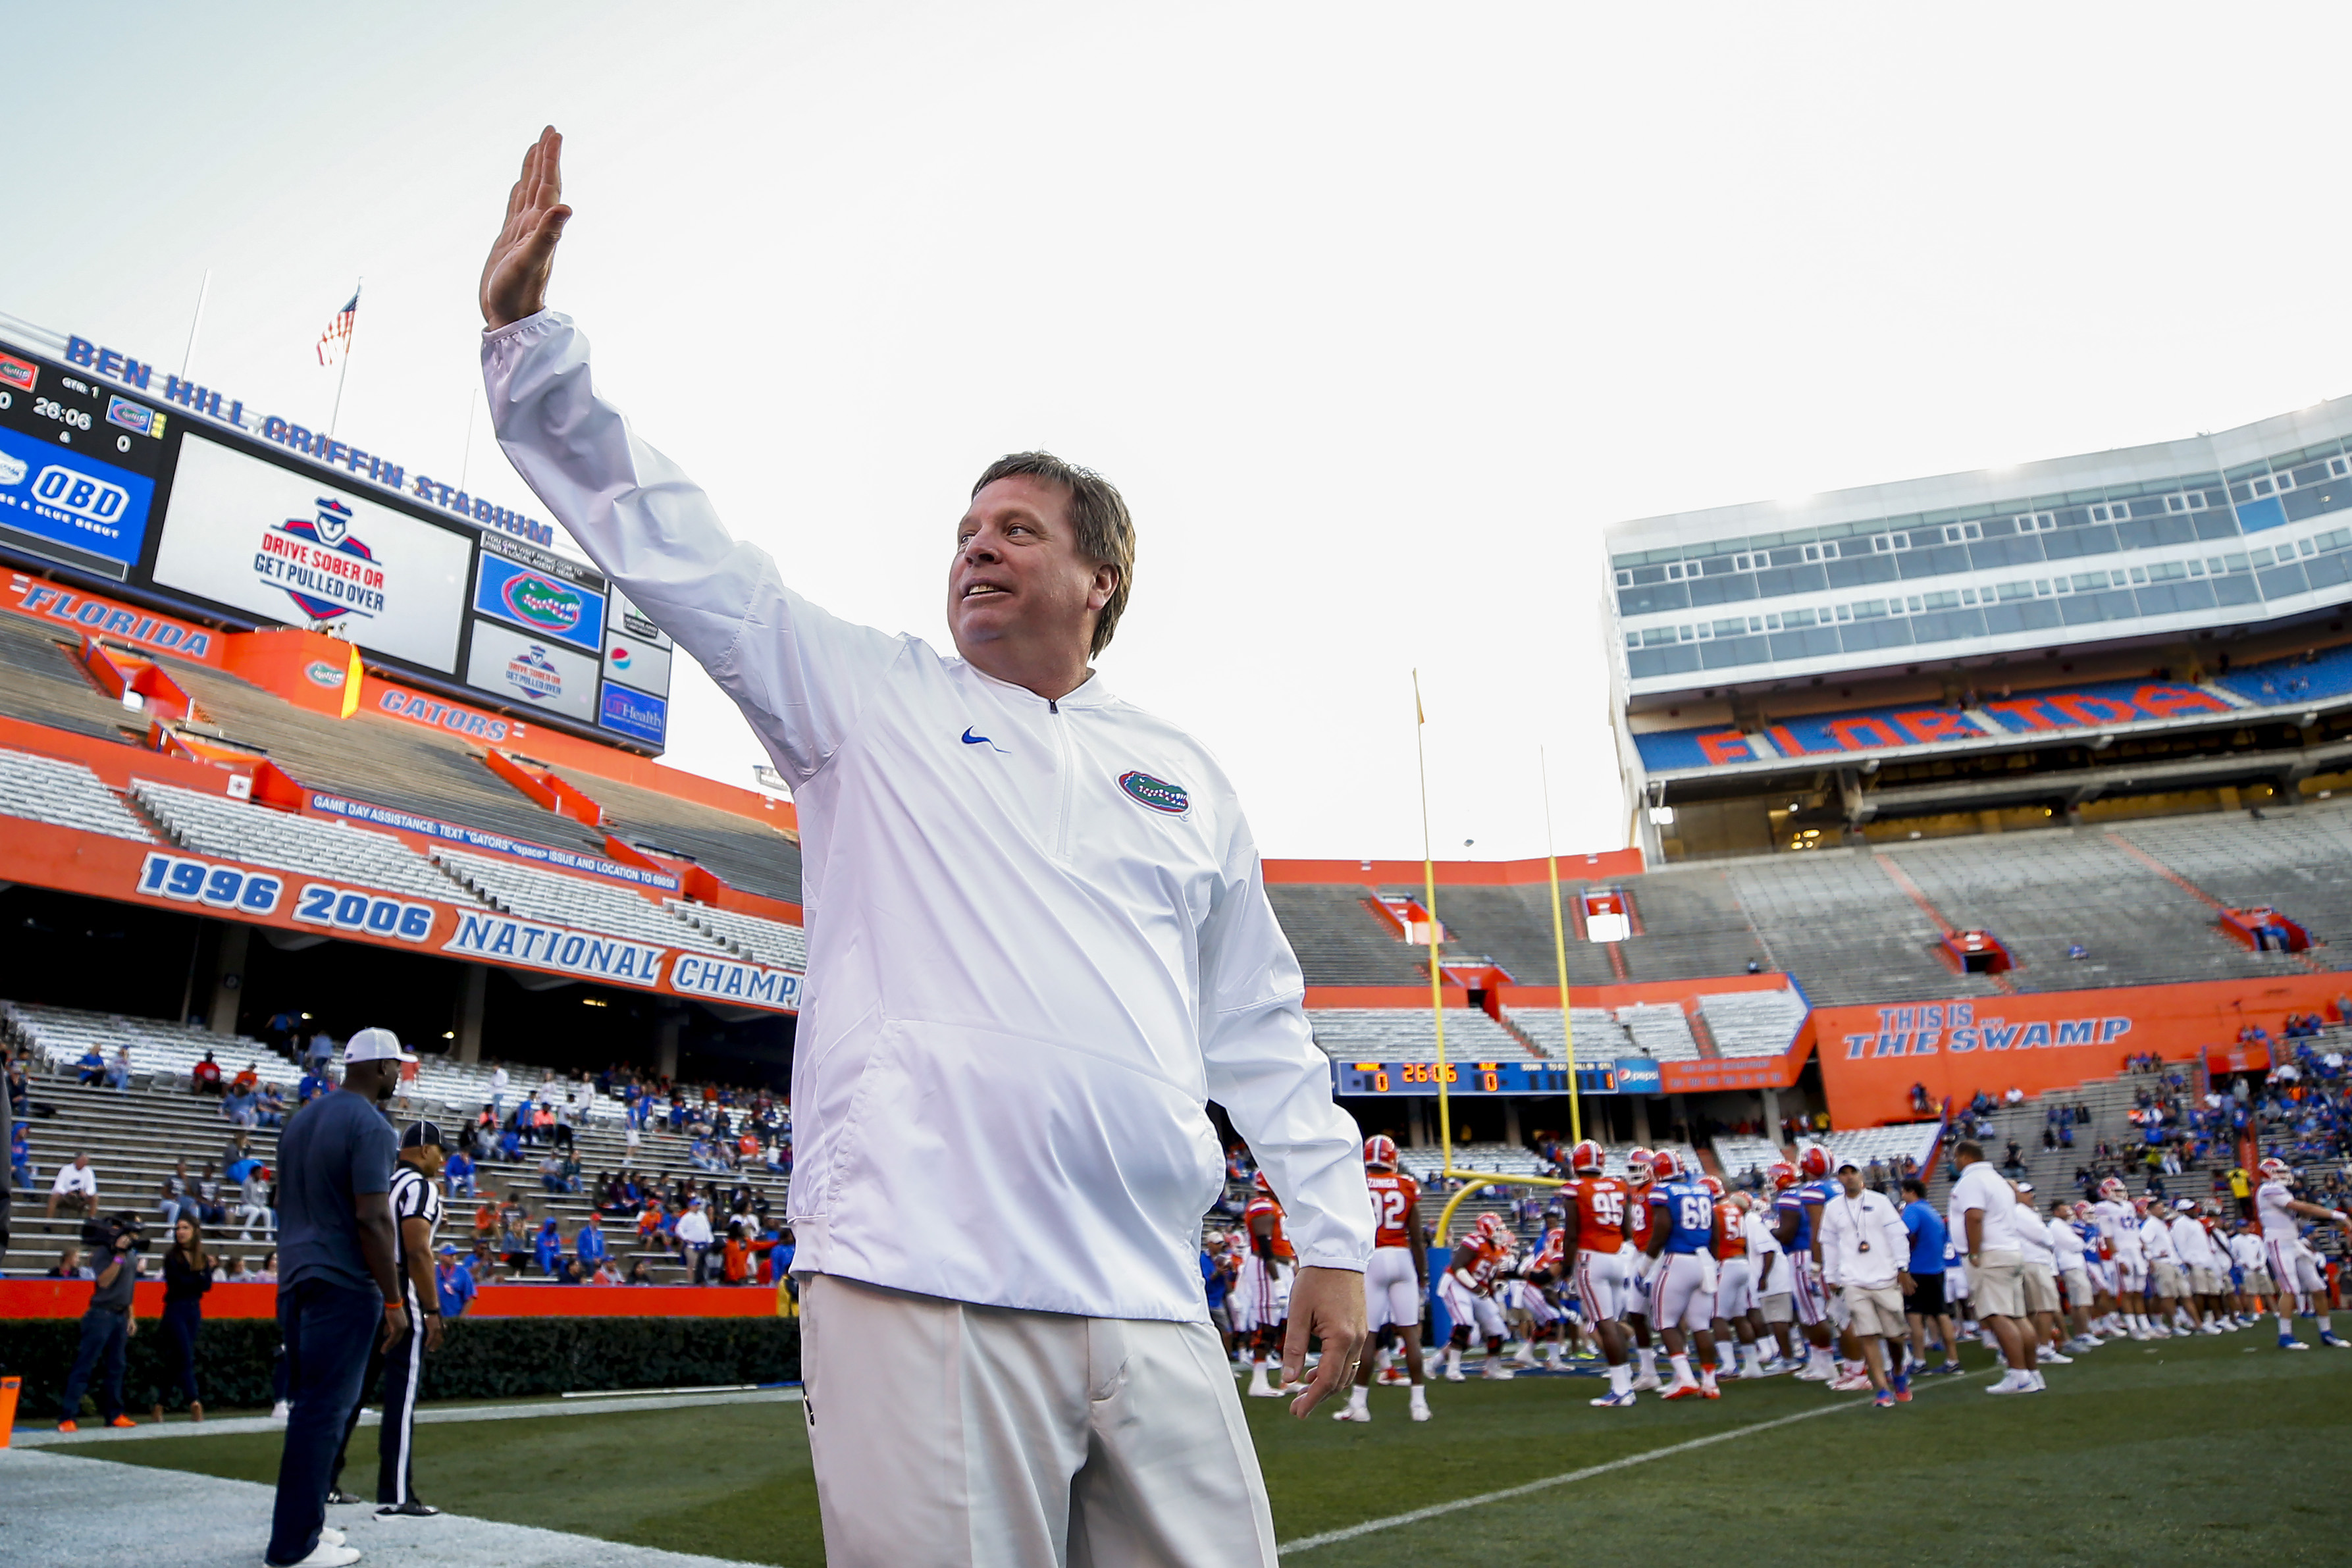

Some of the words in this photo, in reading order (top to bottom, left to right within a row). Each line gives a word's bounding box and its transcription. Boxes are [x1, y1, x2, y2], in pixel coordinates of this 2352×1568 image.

[33, 397, 92, 431] 26:06
[66, 334, 151, 390] BEN
[165, 374, 249, 429] HILL
[263, 416, 404, 489] GRIFFIN
[415, 475, 553, 547] STADIUM
[117, 435, 132, 453] 0
[36, 468, 125, 521] OBD
[253, 554, 283, 579] GET
[286, 562, 344, 600] PULLED
[347, 584, 384, 612] OVER
[262, 531, 309, 564] DRIVE
[310, 546, 361, 581] SOBER
[363, 567, 384, 589] OR
[18, 585, 211, 658] FLORIDA
[379, 689, 509, 741] GATORS
[1697, 685, 2234, 765] FLORIDA
[313, 795, 347, 814] GAME
[348, 803, 370, 819] DAY
[370, 808, 436, 834] ASSISTANCE:
[440, 825, 463, 840] TEXT
[548, 850, 575, 866] ISSUE
[577, 857, 595, 871] AND
[596, 862, 639, 881] LOCATION
[639, 871, 651, 883] TO
[140, 854, 282, 913] 1996
[295, 885, 433, 940] 2006
[453, 913, 663, 983] NATIONAL
[1844, 1030, 1943, 1060] THE
[1949, 1016, 2132, 1053] SWAMP
[1877, 1005, 1944, 1031] THIS
[1375, 1072, 1389, 1092] 0
[1484, 1072, 1498, 1092] 0
[1633, 1070, 1658, 1082] pepsi
[1592, 1191, 1624, 1226] 95
[1681, 1196, 1712, 1230] 68
